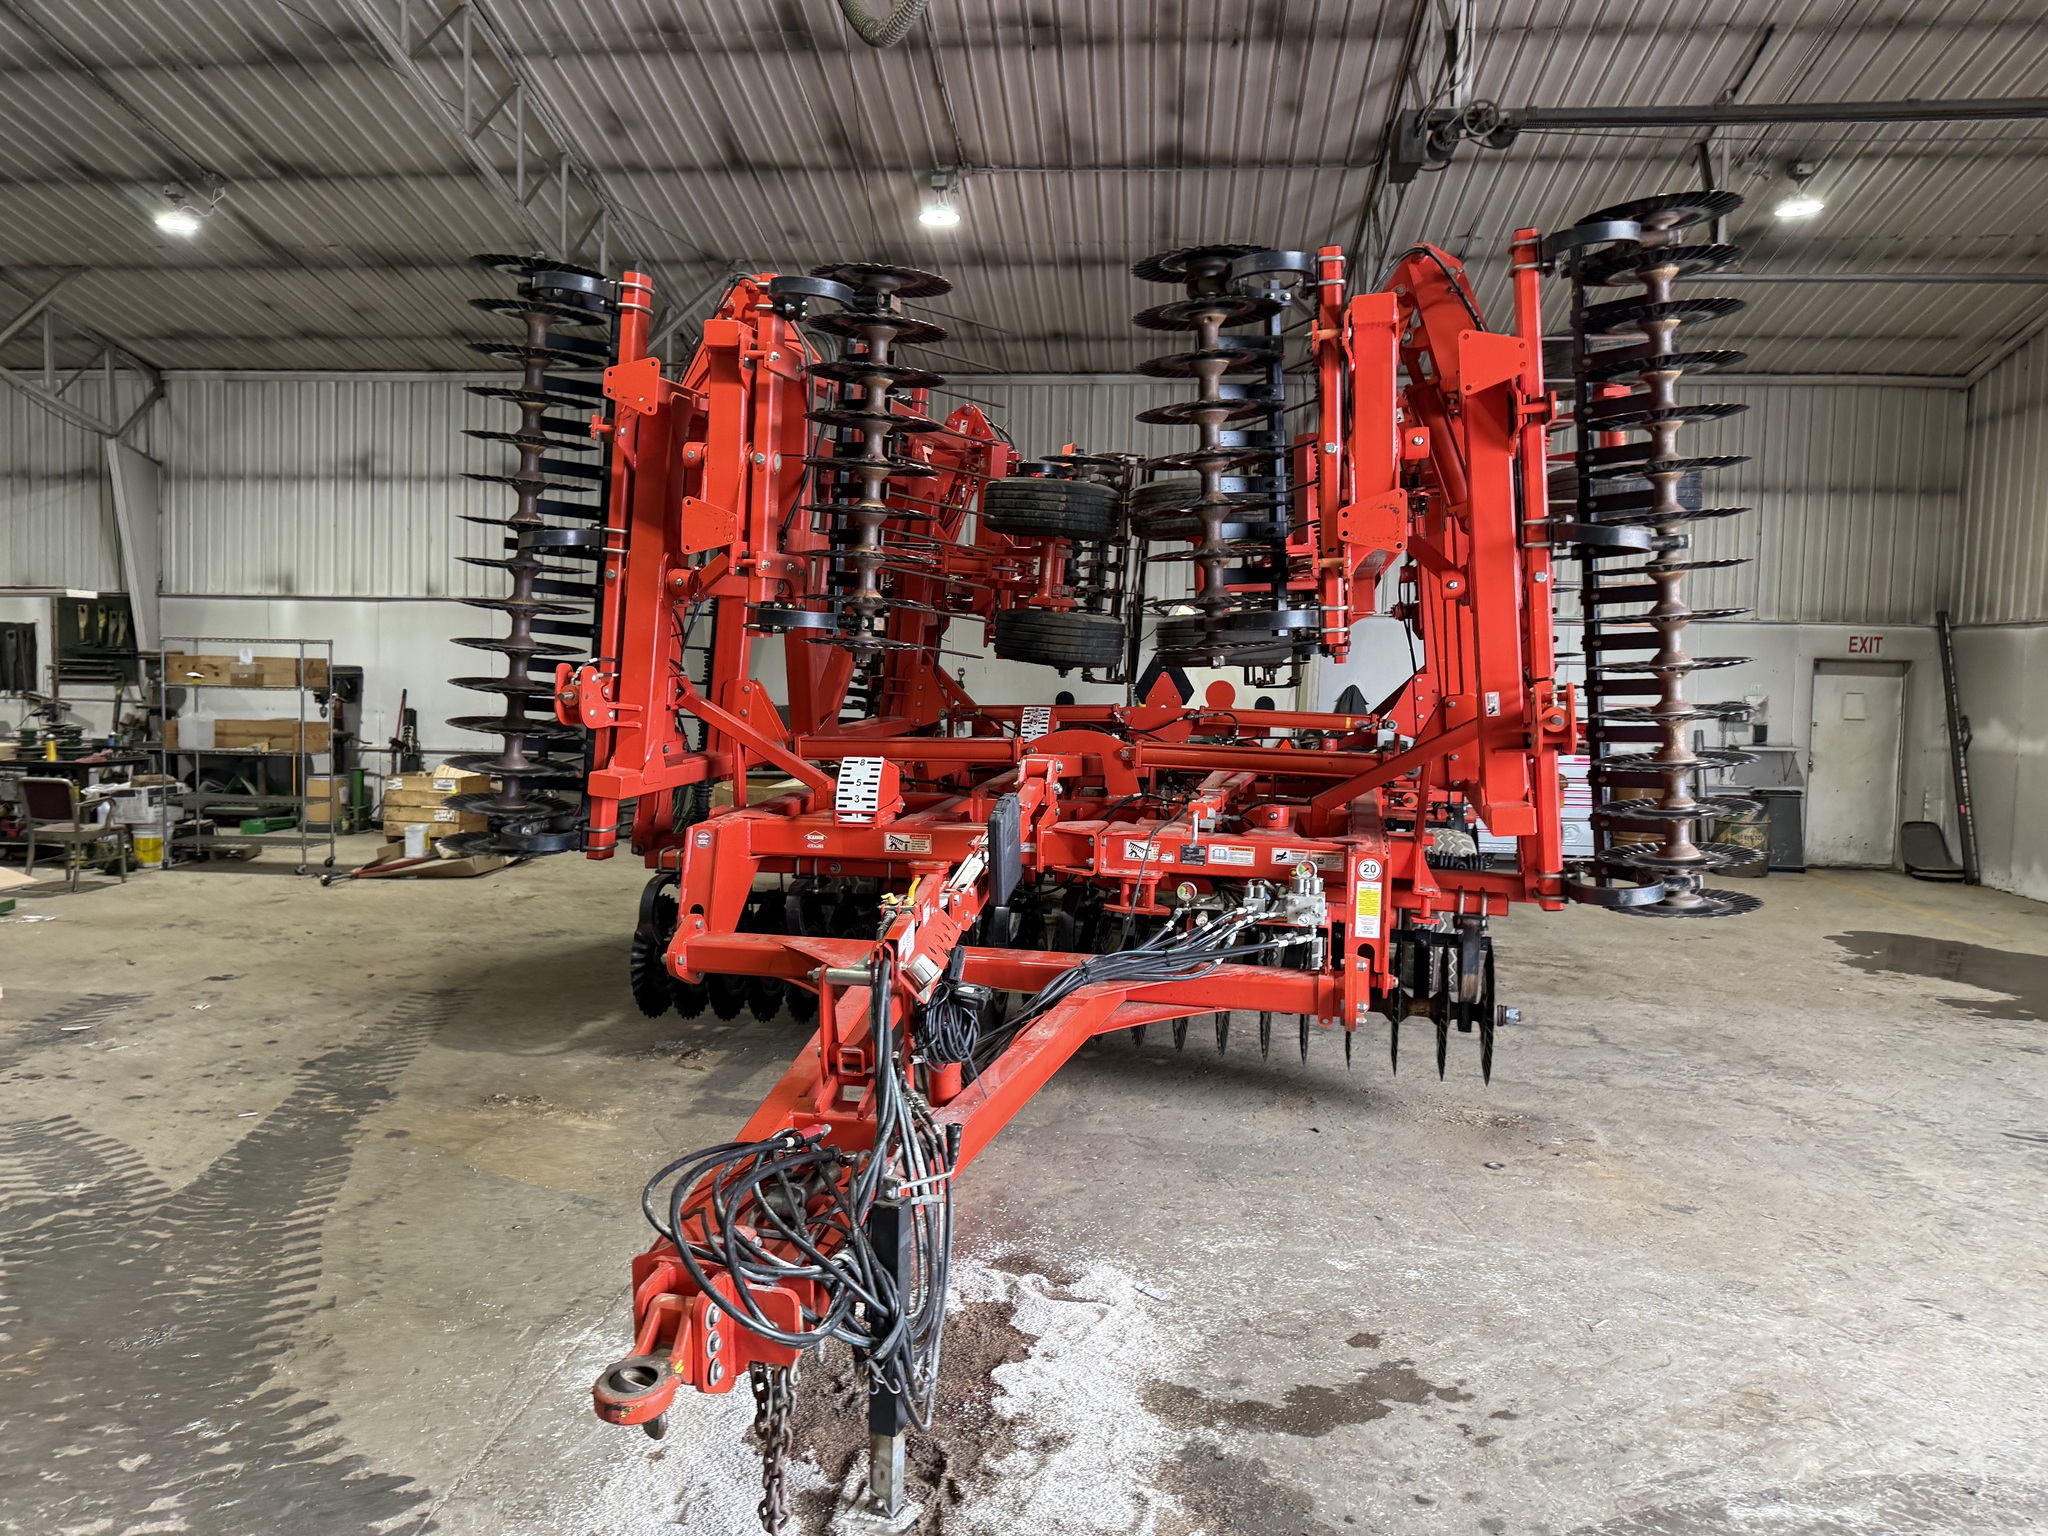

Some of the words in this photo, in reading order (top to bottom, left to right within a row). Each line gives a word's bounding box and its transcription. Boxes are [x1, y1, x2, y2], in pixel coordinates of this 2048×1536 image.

[1848, 636, 1884, 653] EXIT
[855, 779, 862, 787] 5
[854, 795, 860, 803] 3
[1363, 864, 1377, 873] 20
